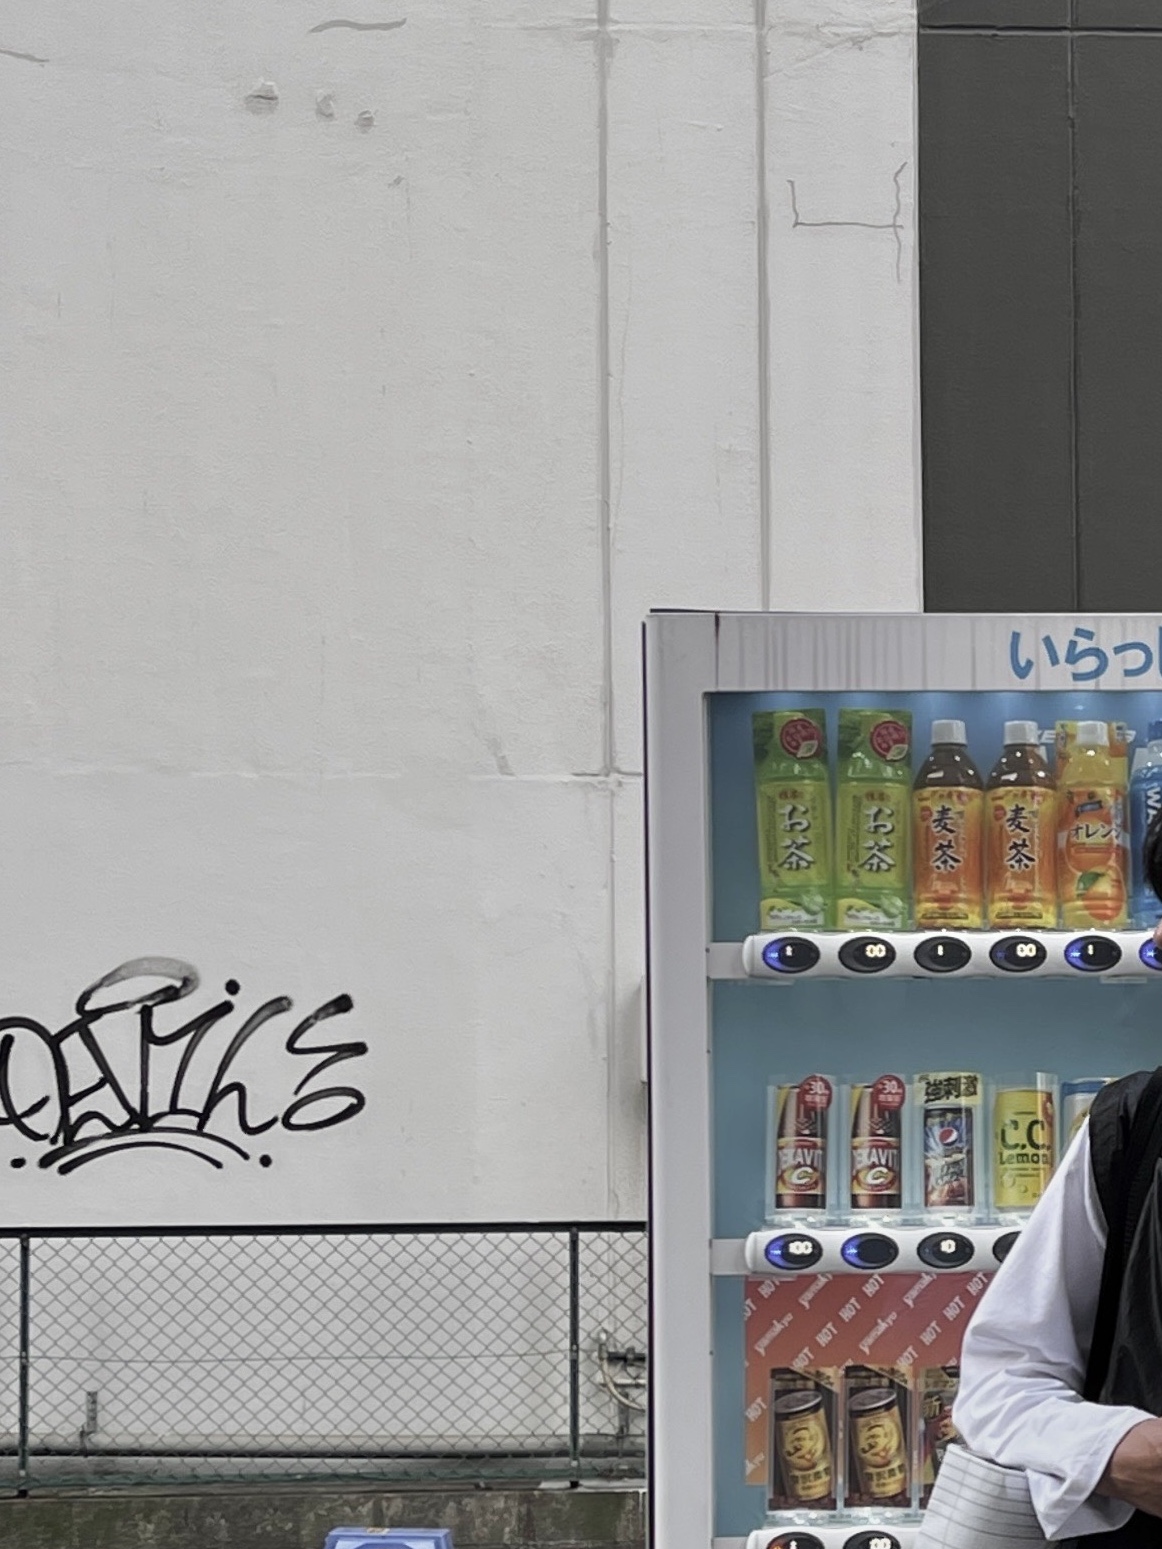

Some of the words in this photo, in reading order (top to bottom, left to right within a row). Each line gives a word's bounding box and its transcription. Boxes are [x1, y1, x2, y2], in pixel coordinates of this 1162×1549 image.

[777, 804, 815, 870] お茶
[859, 805, 896, 872] お茶
[931, 804, 962, 871] 麦茶
[1005, 803, 1036, 871] 麦茶
[1000, 1151, 1049, 1165] Lemon
